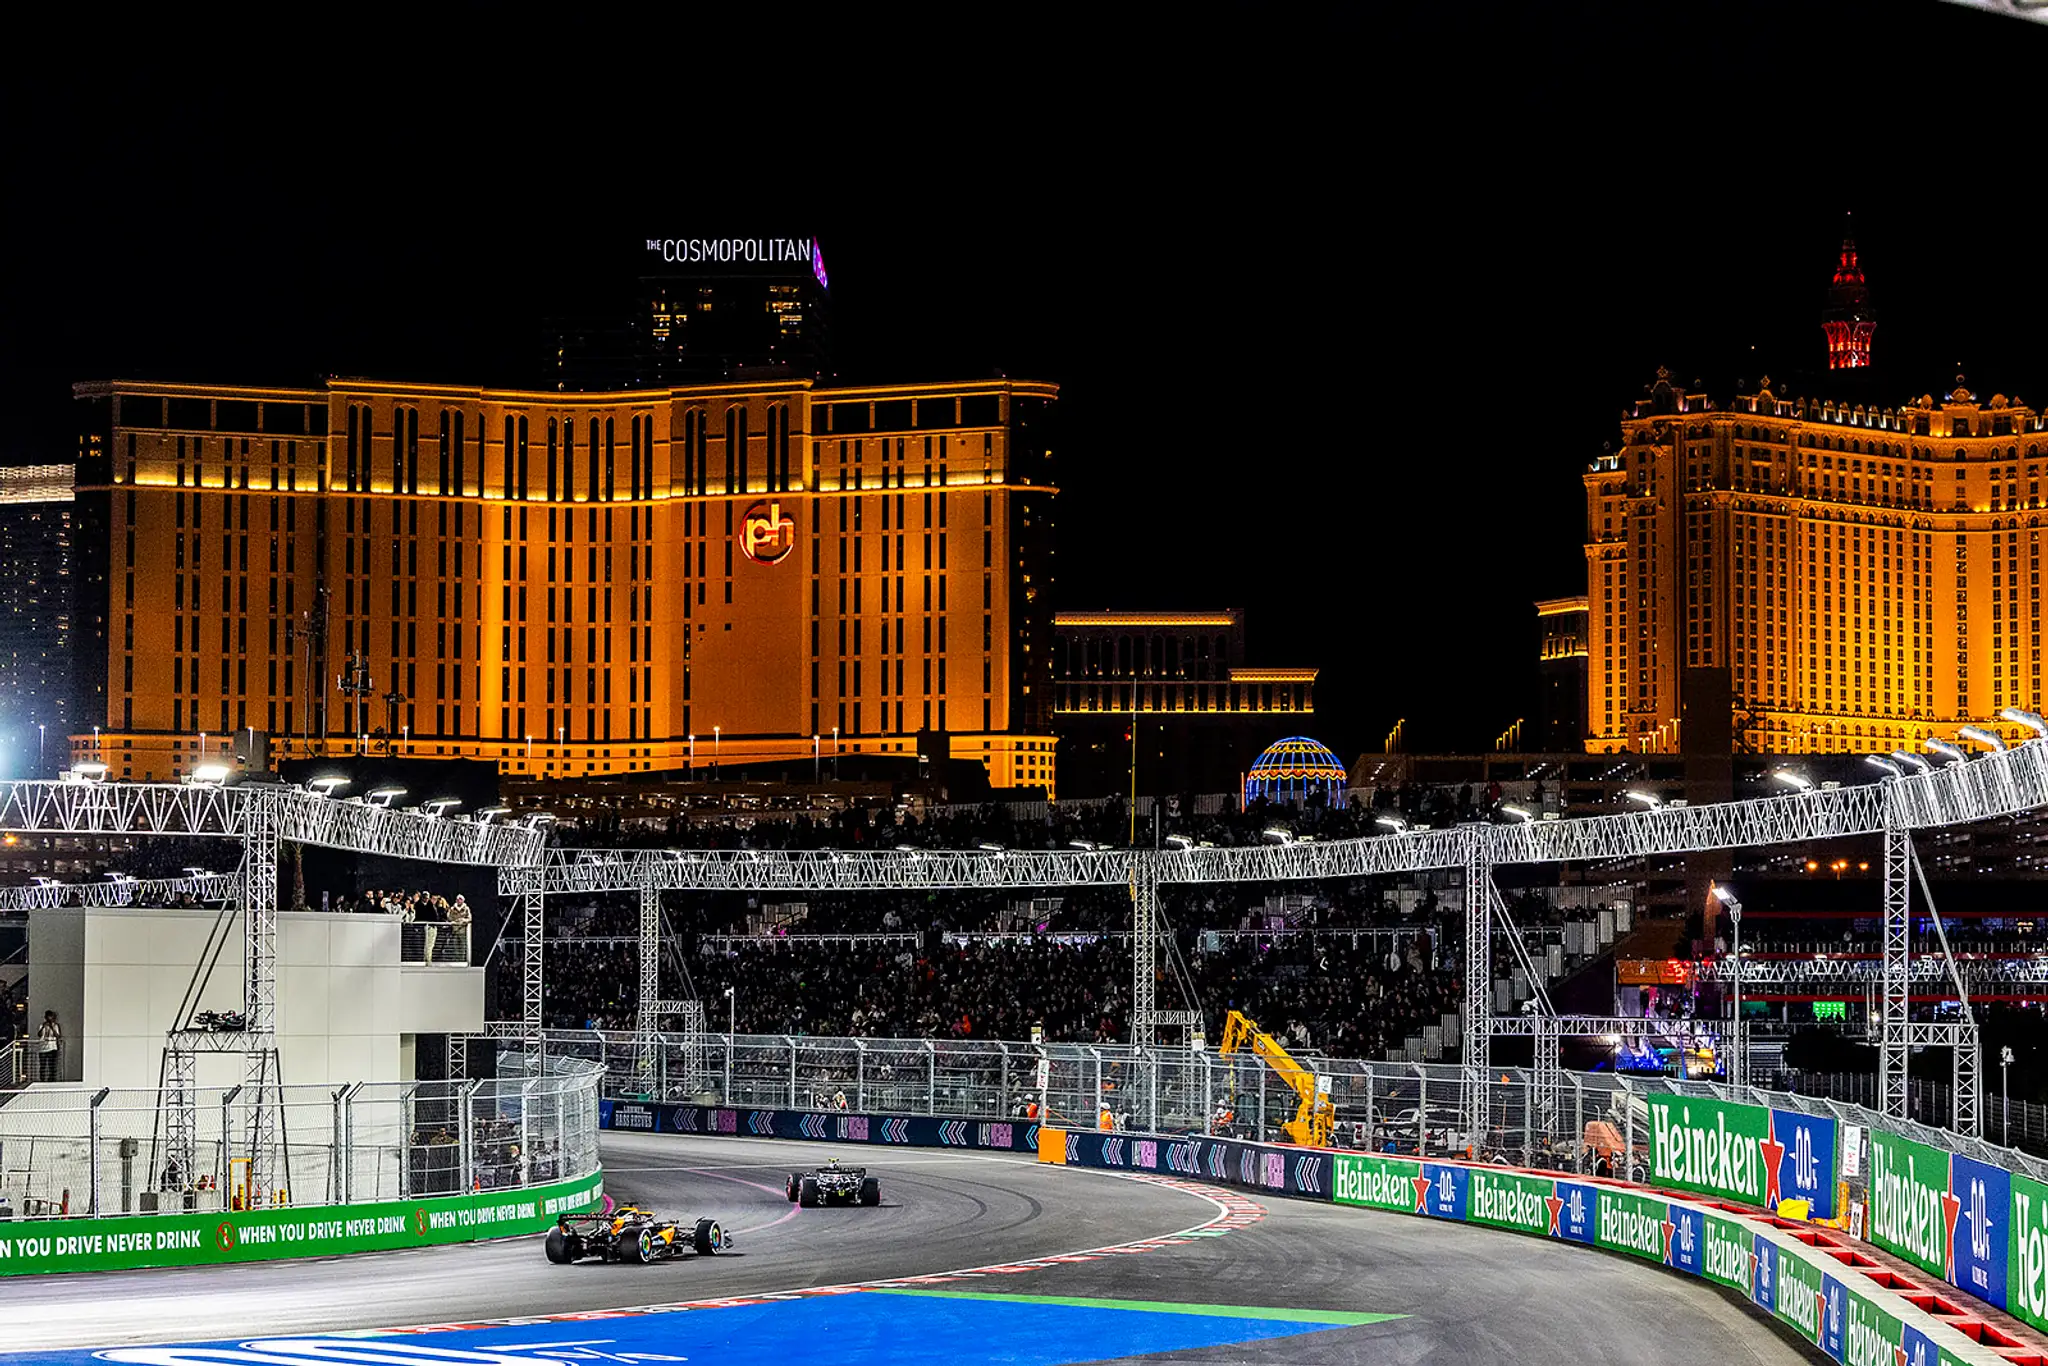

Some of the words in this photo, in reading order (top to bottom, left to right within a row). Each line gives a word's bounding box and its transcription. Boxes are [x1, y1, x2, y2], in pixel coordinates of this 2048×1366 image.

[646, 239, 661, 250] THE
[663, 239, 811, 262] COSMOPOLITAN
[1651, 1103, 1758, 1197] Heineken
[1336, 1159, 1410, 1206] Heineken
[1474, 1175, 1543, 1228] Heineken
[1873, 1142, 1941, 1266] Heineken
[238, 1225, 277, 1244] WHEN
[279, 1222, 305, 1242] YOU
[308, 1220, 343, 1240] DRIVE
[345, 1218, 376, 1237] NEVER
[377, 1215, 406, 1235] DRINK
[429, 1212, 457, 1229] WHEN
[457, 1209, 476, 1226] YOU
[1600, 1195, 1660, 1256] Heineken
[15, 1237, 51, 1257] YOU
[56, 1235, 103, 1256] DRIVE
[106, 1232, 152, 1253] NEVER
[156, 1229, 201, 1250] DRINK
